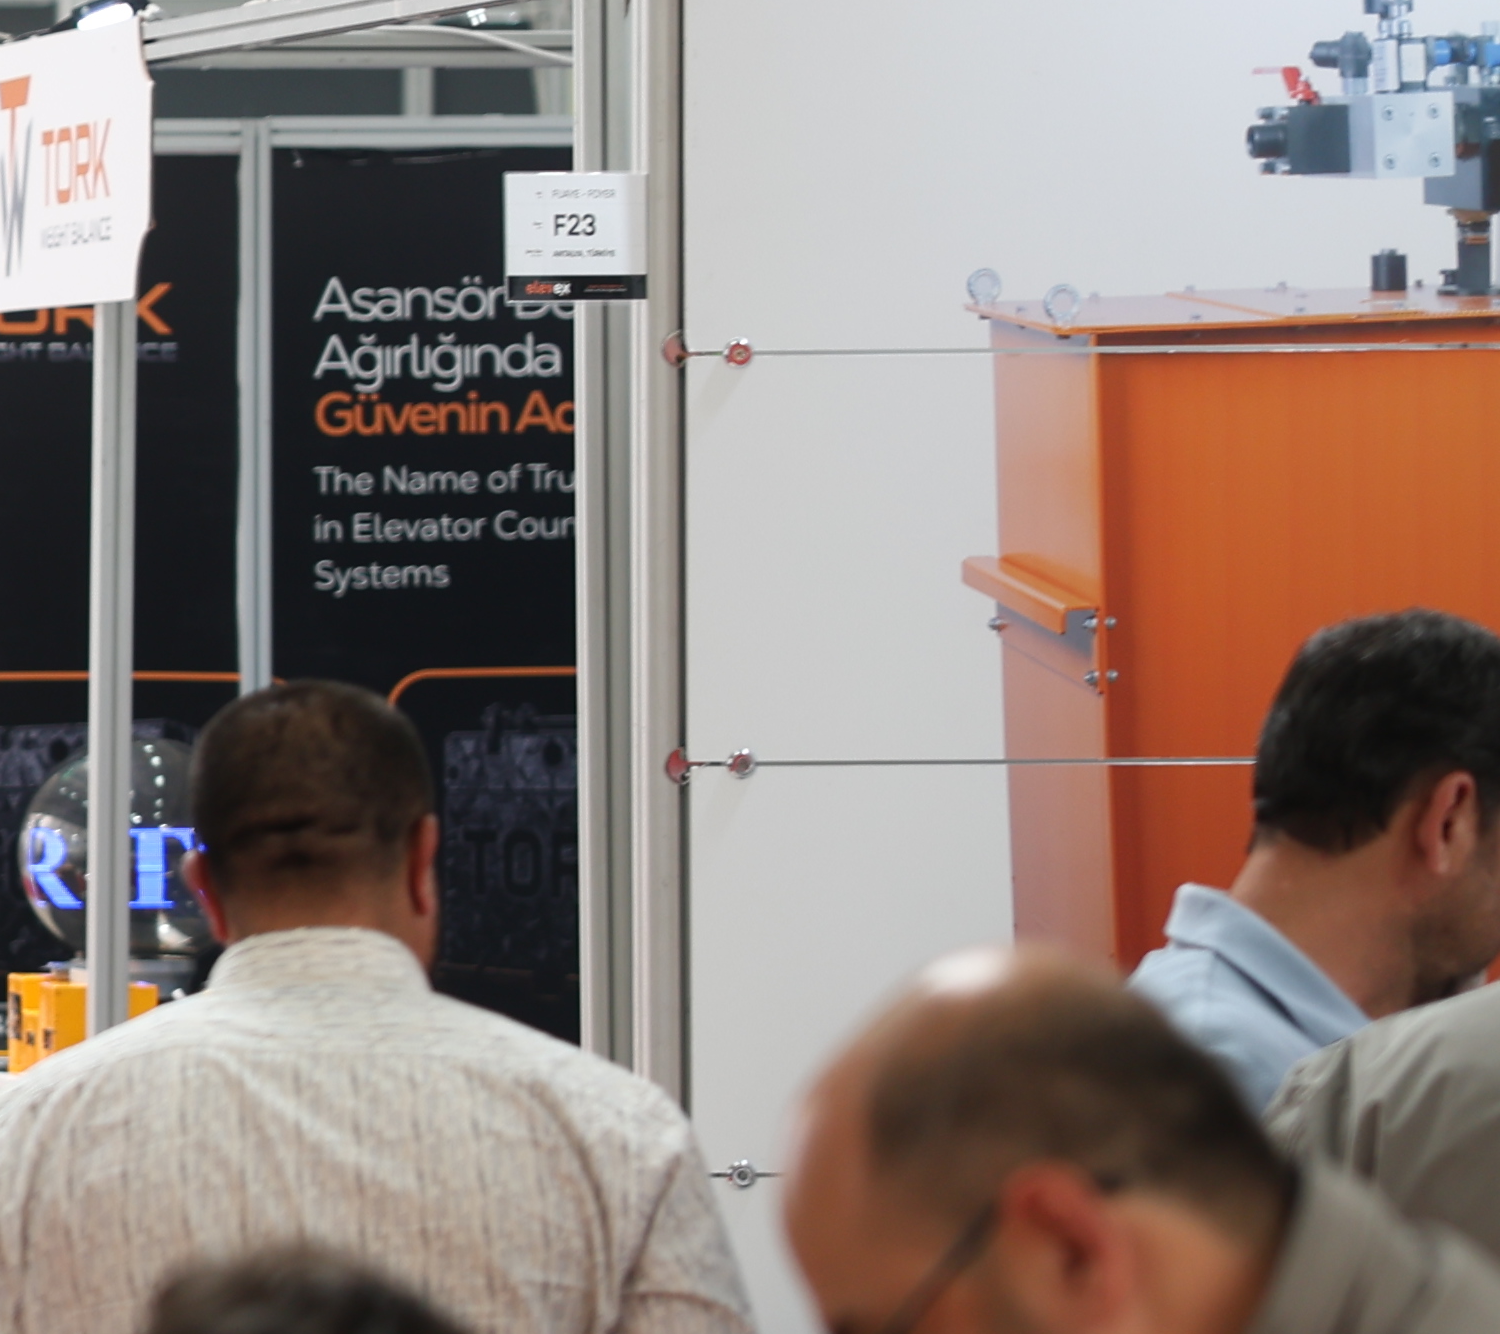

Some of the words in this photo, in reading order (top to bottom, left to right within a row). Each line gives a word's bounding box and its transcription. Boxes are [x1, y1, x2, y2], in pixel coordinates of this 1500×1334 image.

[40, 117, 113, 209] TORK
[553, 213, 597, 237] F23
[312, 274, 506, 323] Asansör
[312, 331, 563, 393] Ağırlığında
[313, 389, 510, 438] Güvenin
[313, 464, 375, 496] The
[382, 464, 481, 495] Name
[486, 462, 522, 493] of
[313, 514, 343, 542] in
[352, 511, 487, 543] Elevator
[313, 559, 451, 598] Systems
